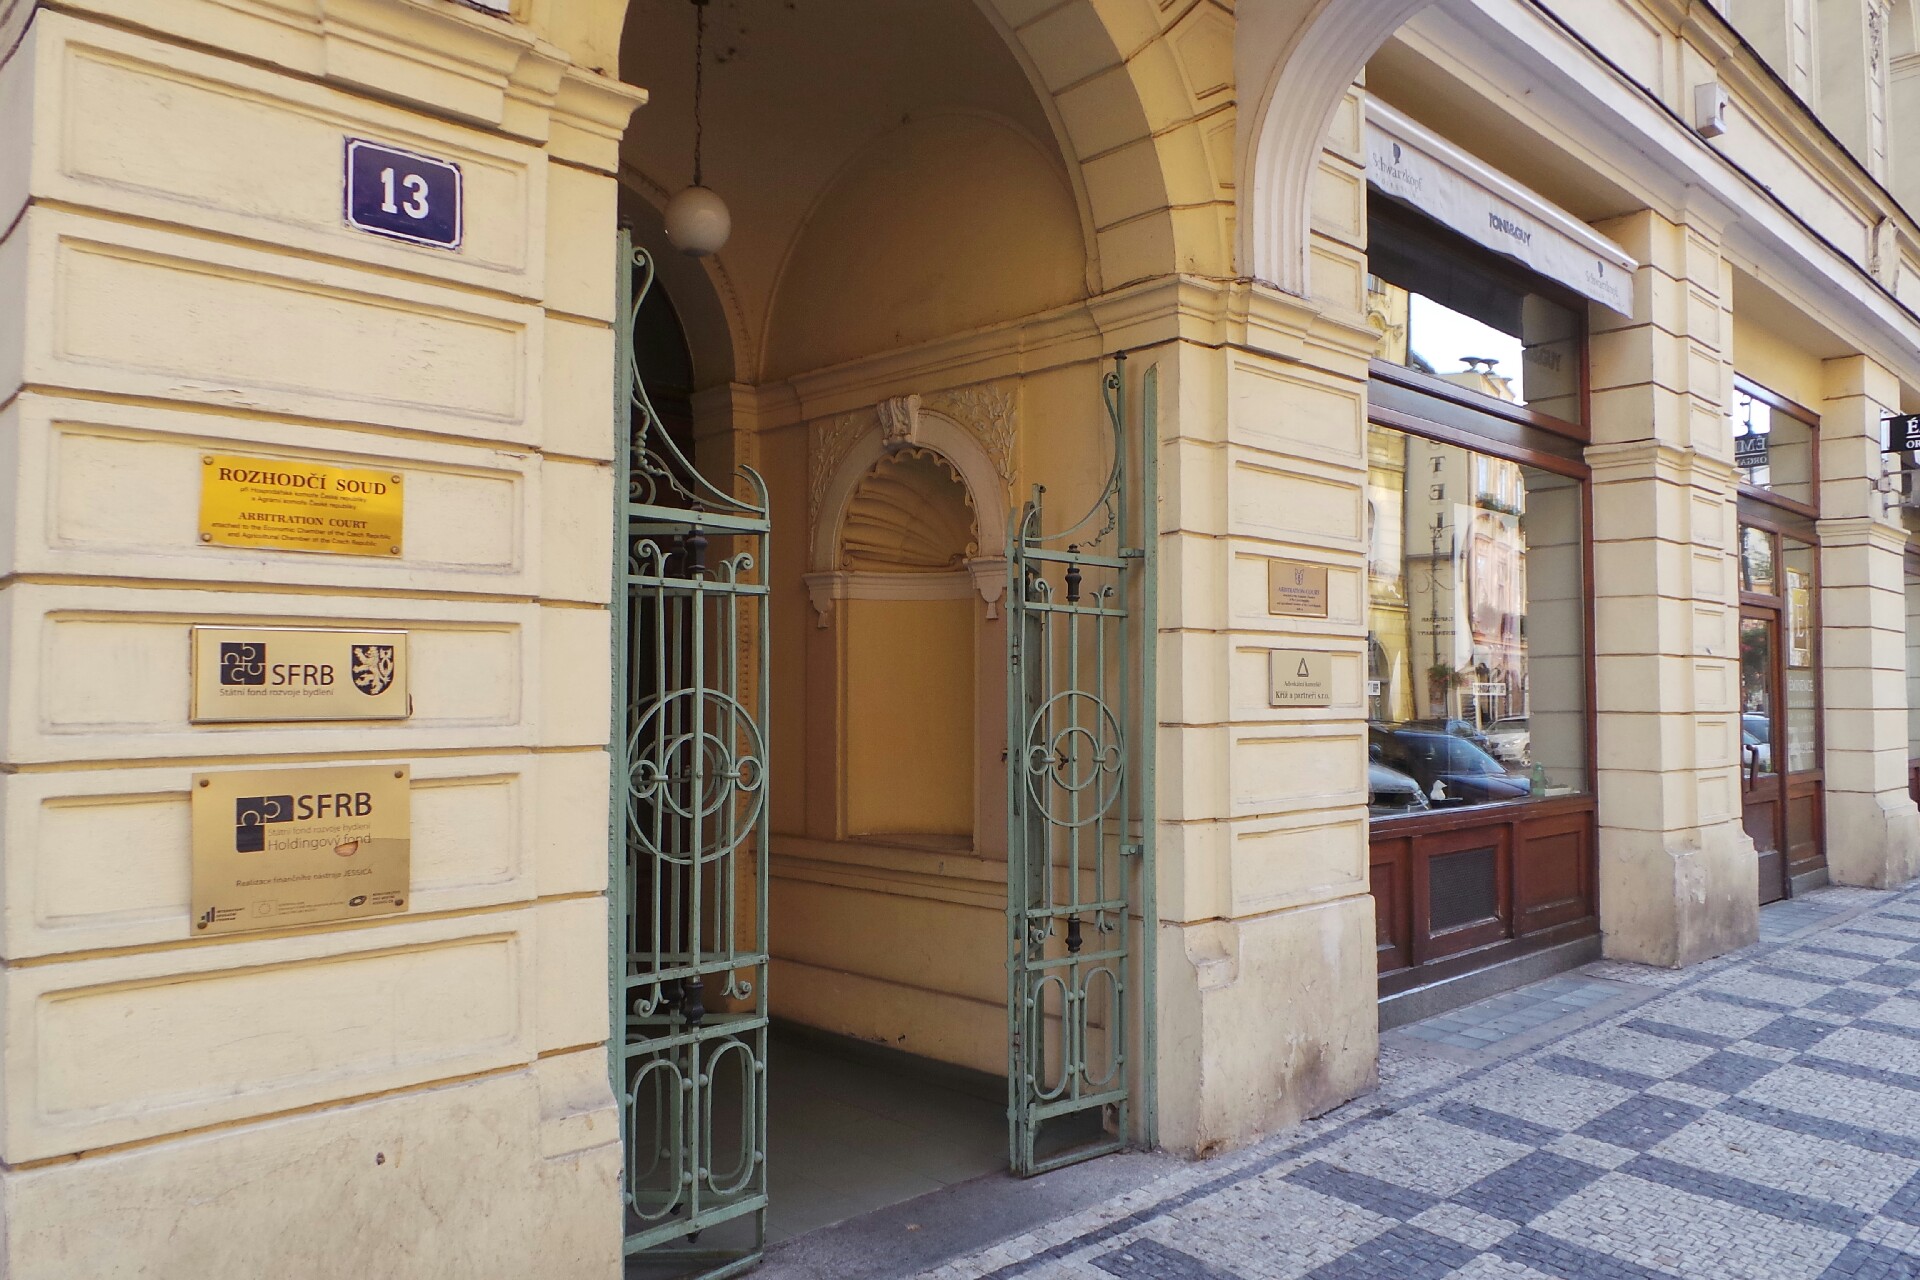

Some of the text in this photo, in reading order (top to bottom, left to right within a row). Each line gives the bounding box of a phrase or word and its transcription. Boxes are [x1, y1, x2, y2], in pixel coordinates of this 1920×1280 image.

[1372, 152, 1423, 192] Schwarzkopf
[380, 167, 429, 219] 13
[1489, 212, 1531, 246] TONI&GUY
[219, 467, 387, 496] ROZHODČÍ SOUD
[238, 512, 368, 529] ARBITRATION COURT
[242, 532, 279, 540] Agricultural
[281, 534, 310, 542] Chamber
[351, 539, 377, 547] Republic
[263, 525, 295, 533] Economic
[297, 527, 326, 535] Chamber
[365, 532, 391, 540] Republic
[272, 664, 335, 686] SFRB
[219, 688, 335, 697] Státní fond rozvoje bydlení
[297, 792, 372, 820] SFRB
[268, 822, 371, 837] Státní fond rozvoje bydlení
[268, 832, 371, 851] Holdingový fond
[235, 879, 272, 887] Realizace
[342, 868, 373, 877] JESSICA
